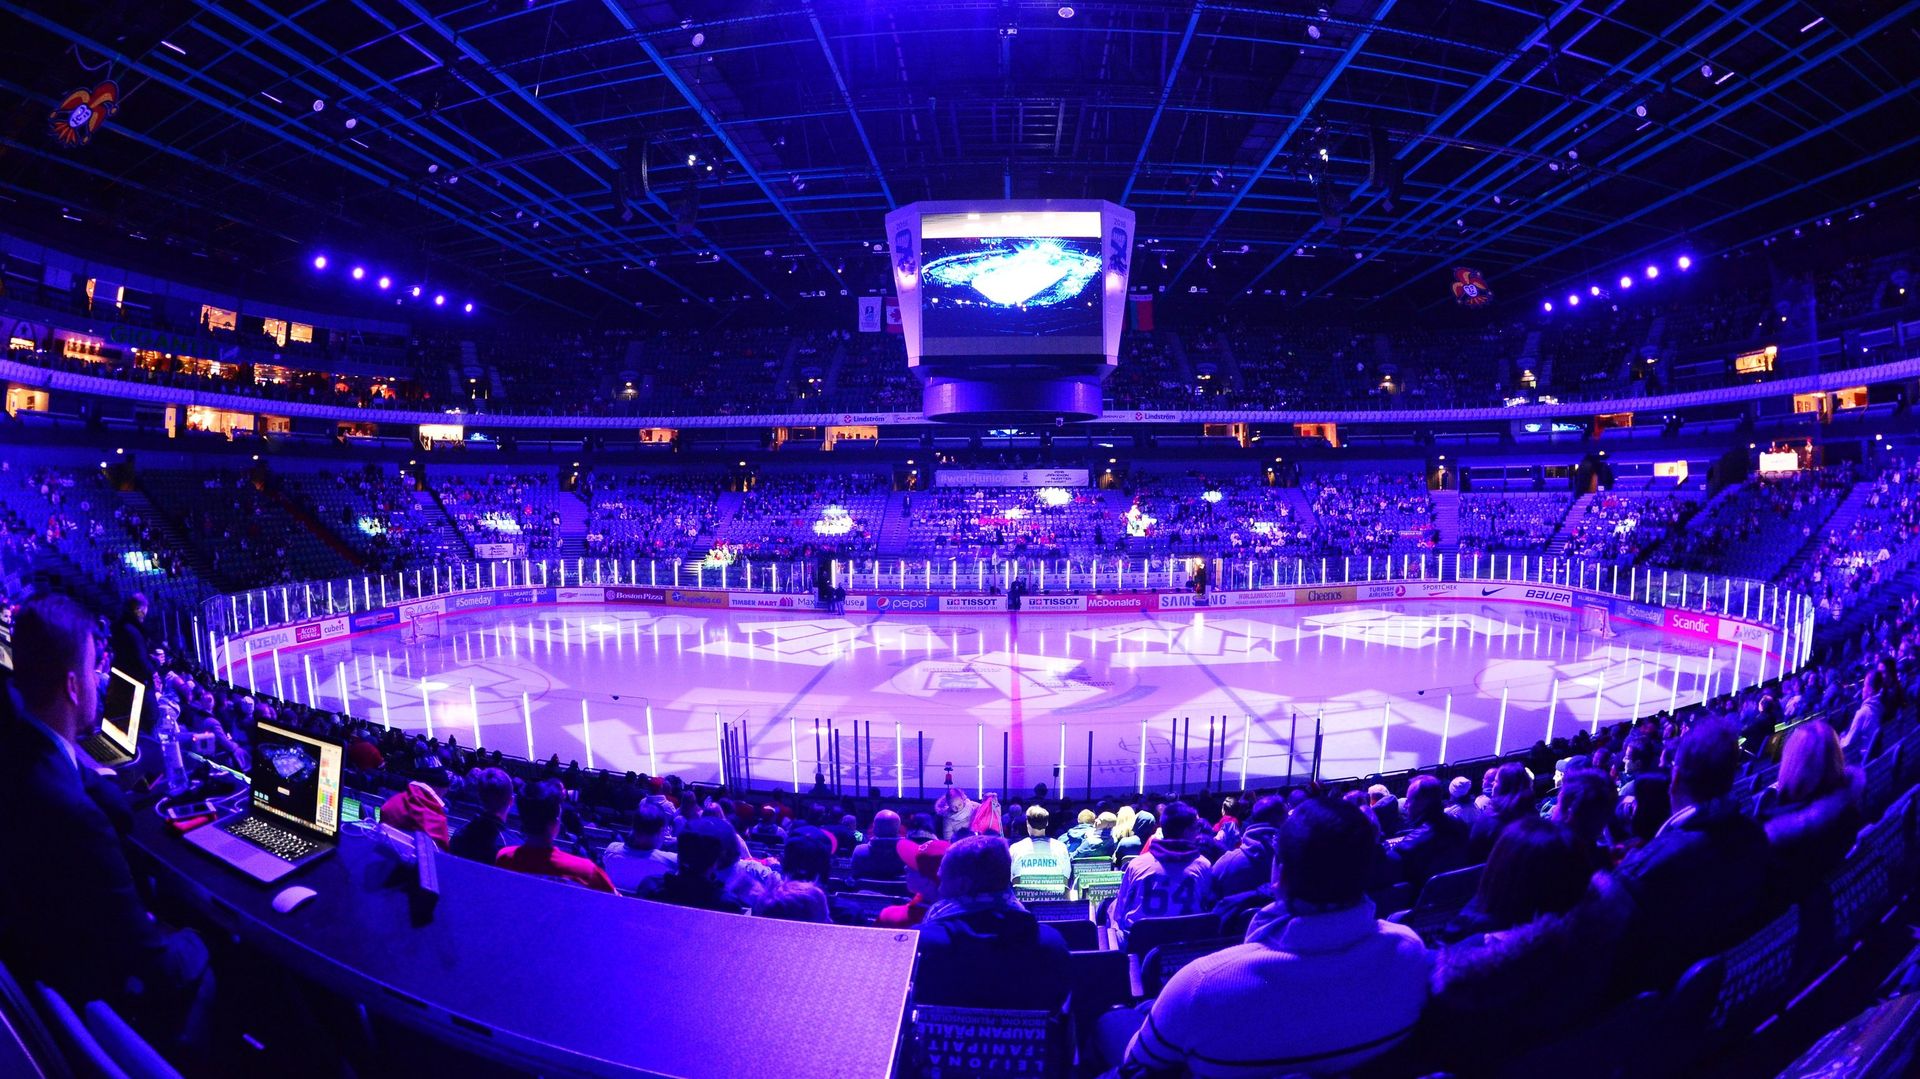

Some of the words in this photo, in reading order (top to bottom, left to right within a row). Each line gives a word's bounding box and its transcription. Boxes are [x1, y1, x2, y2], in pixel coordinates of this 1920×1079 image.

[455, 594, 492, 608] #Someday
[892, 597, 927, 610] pepsi
[961, 598, 998, 606] TISSOT
[1088, 598, 1141, 607] McDonald's
[1161, 594, 1227, 607] SAMSNG
[1672, 614, 1710, 634] Scandic
[243, 632, 289, 653] ILTEMA
[1021, 858, 1058, 869] KAPANEN
[1142, 874, 1196, 916] 64
[978, 1026, 1046, 1040] KAUPAN
[929, 1054, 1044, 1072] LEIJONA
